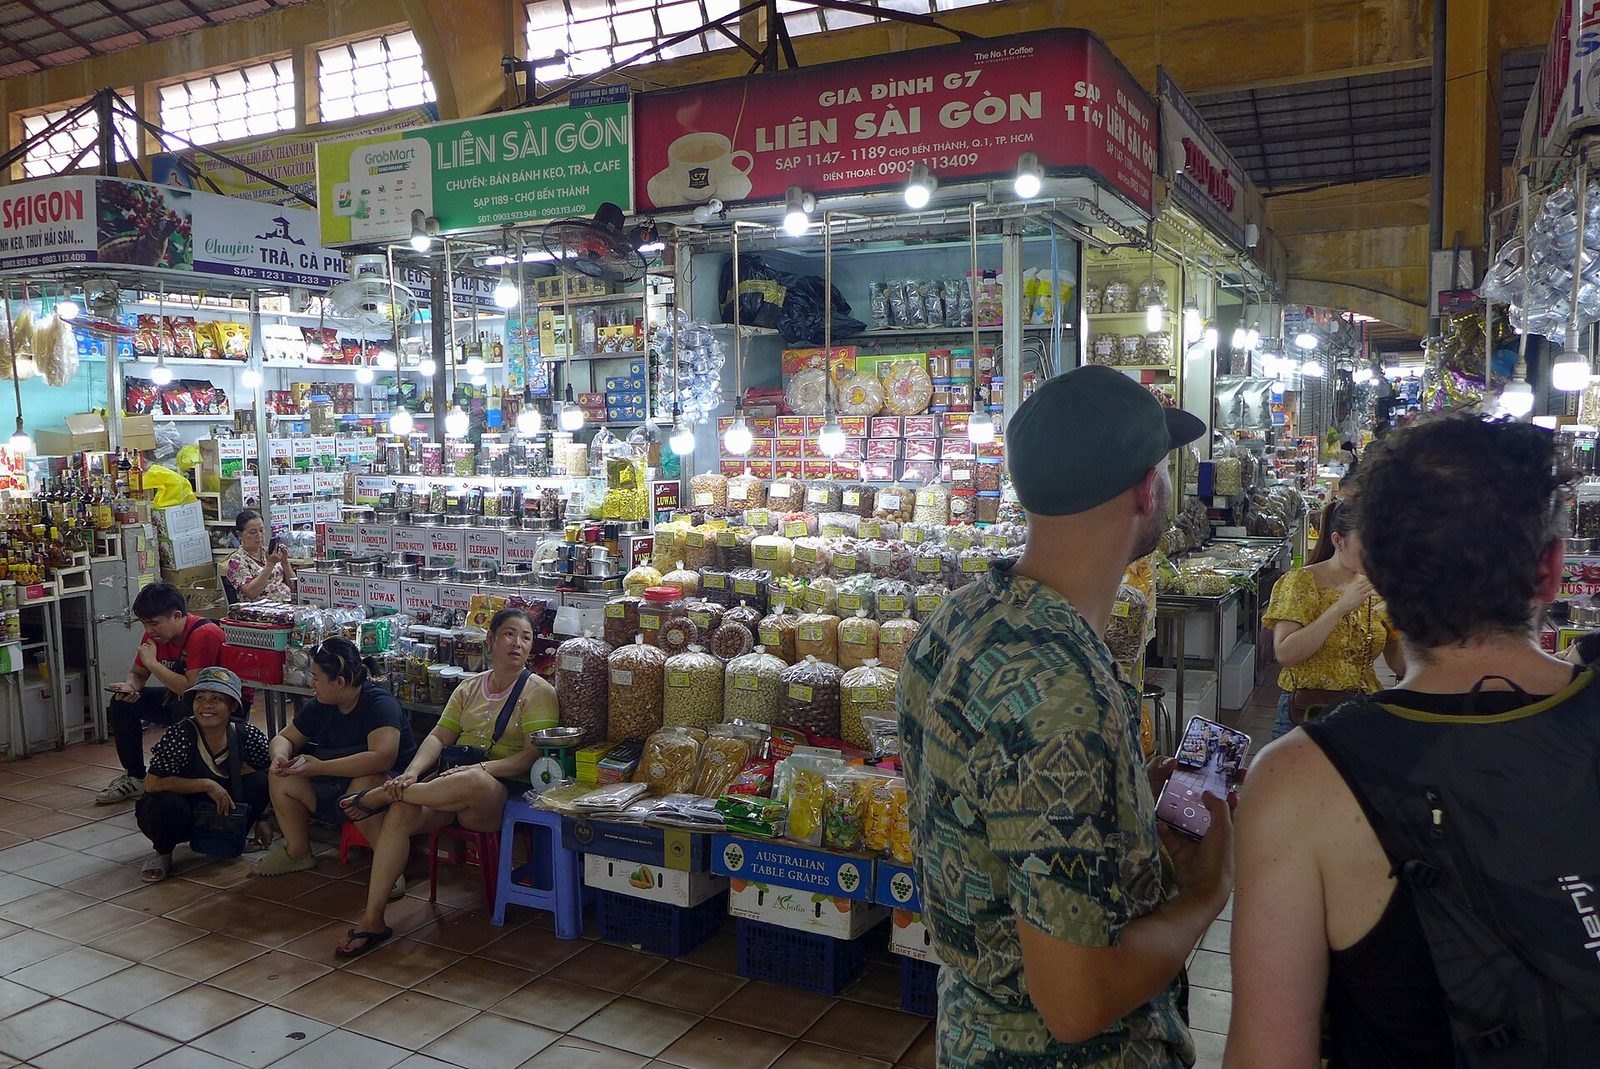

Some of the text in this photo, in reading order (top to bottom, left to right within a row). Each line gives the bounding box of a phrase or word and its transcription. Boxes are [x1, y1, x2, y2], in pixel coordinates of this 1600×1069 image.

[990, 49, 1006, 58] No.1
[1008, 46, 1034, 56] Coffee
[818, 69, 982, 108] GIA ĐÌNH G7
[1074, 81, 1101, 104] SẠP
[755, 90, 1043, 153] LIÊN SÀI GÒN
[1107, 104, 1126, 147] LIÊN
[1128, 124, 1140, 161] SÀI
[438, 130, 496, 170] LIÊN
[502, 120, 548, 161] SÀI
[555, 112, 628, 153] GÒN
[364, 148, 416, 164] GrabMart
[775, 156, 801, 171] SẠP
[851, 146, 887, 162] 1189
[888, 146, 910, 158] CHỢ
[912, 140, 930, 154] BẾN
[934, 138, 968, 152] THÀNH,
[972, 138, 993, 149] Q.1,
[995, 135, 1008, 145] TP.
[1010, 133, 1034, 143] HCM
[446, 160, 620, 192] CHUYÊN: BÁN BÁNH KẸO, TRÀ, CAFE
[691, 172, 707, 181] G7
[822, 170, 844, 182] ĐIỆN
[846, 168, 876, 180] THOẠI:
[253, 188, 279, 198] MARKET
[473, 196, 490, 209] SẠP
[490, 194, 508, 206] 1189
[514, 190, 535, 204] CHỢ
[537, 186, 556, 200] BẾN
[556, 184, 590, 198] THÀNH
[2, 190, 84, 230] SAIGON
[478, 214, 492, 224] SĐT:
[260, 248, 294, 268] TRÀ,
[300, 252, 319, 270] CÀ
[234, 267, 257, 278] SẠP:
[260, 271, 285, 280] 1231
[296, 275, 320, 284] 1233
[358, 488, 372, 496] WHITE
[656, 496, 676, 506] LUWAK
[329, 534, 354, 543] GREEN TEA
[361, 536, 388, 544] JASMINE TEA
[432, 542, 458, 552] WEASEL
[469, 544, 498, 556] ELEPHANT
[300, 586, 326, 596] JASMINE TEA
[334, 588, 350, 597] LOTUS
[350, 589, 360, 598] TEA
[370, 592, 396, 602] LUWAK
[756, 850, 825, 872] AUSTRALIAN
[750, 863, 830, 886] TABLE GRAPES
[1558, 875, 1600, 962] lenji
